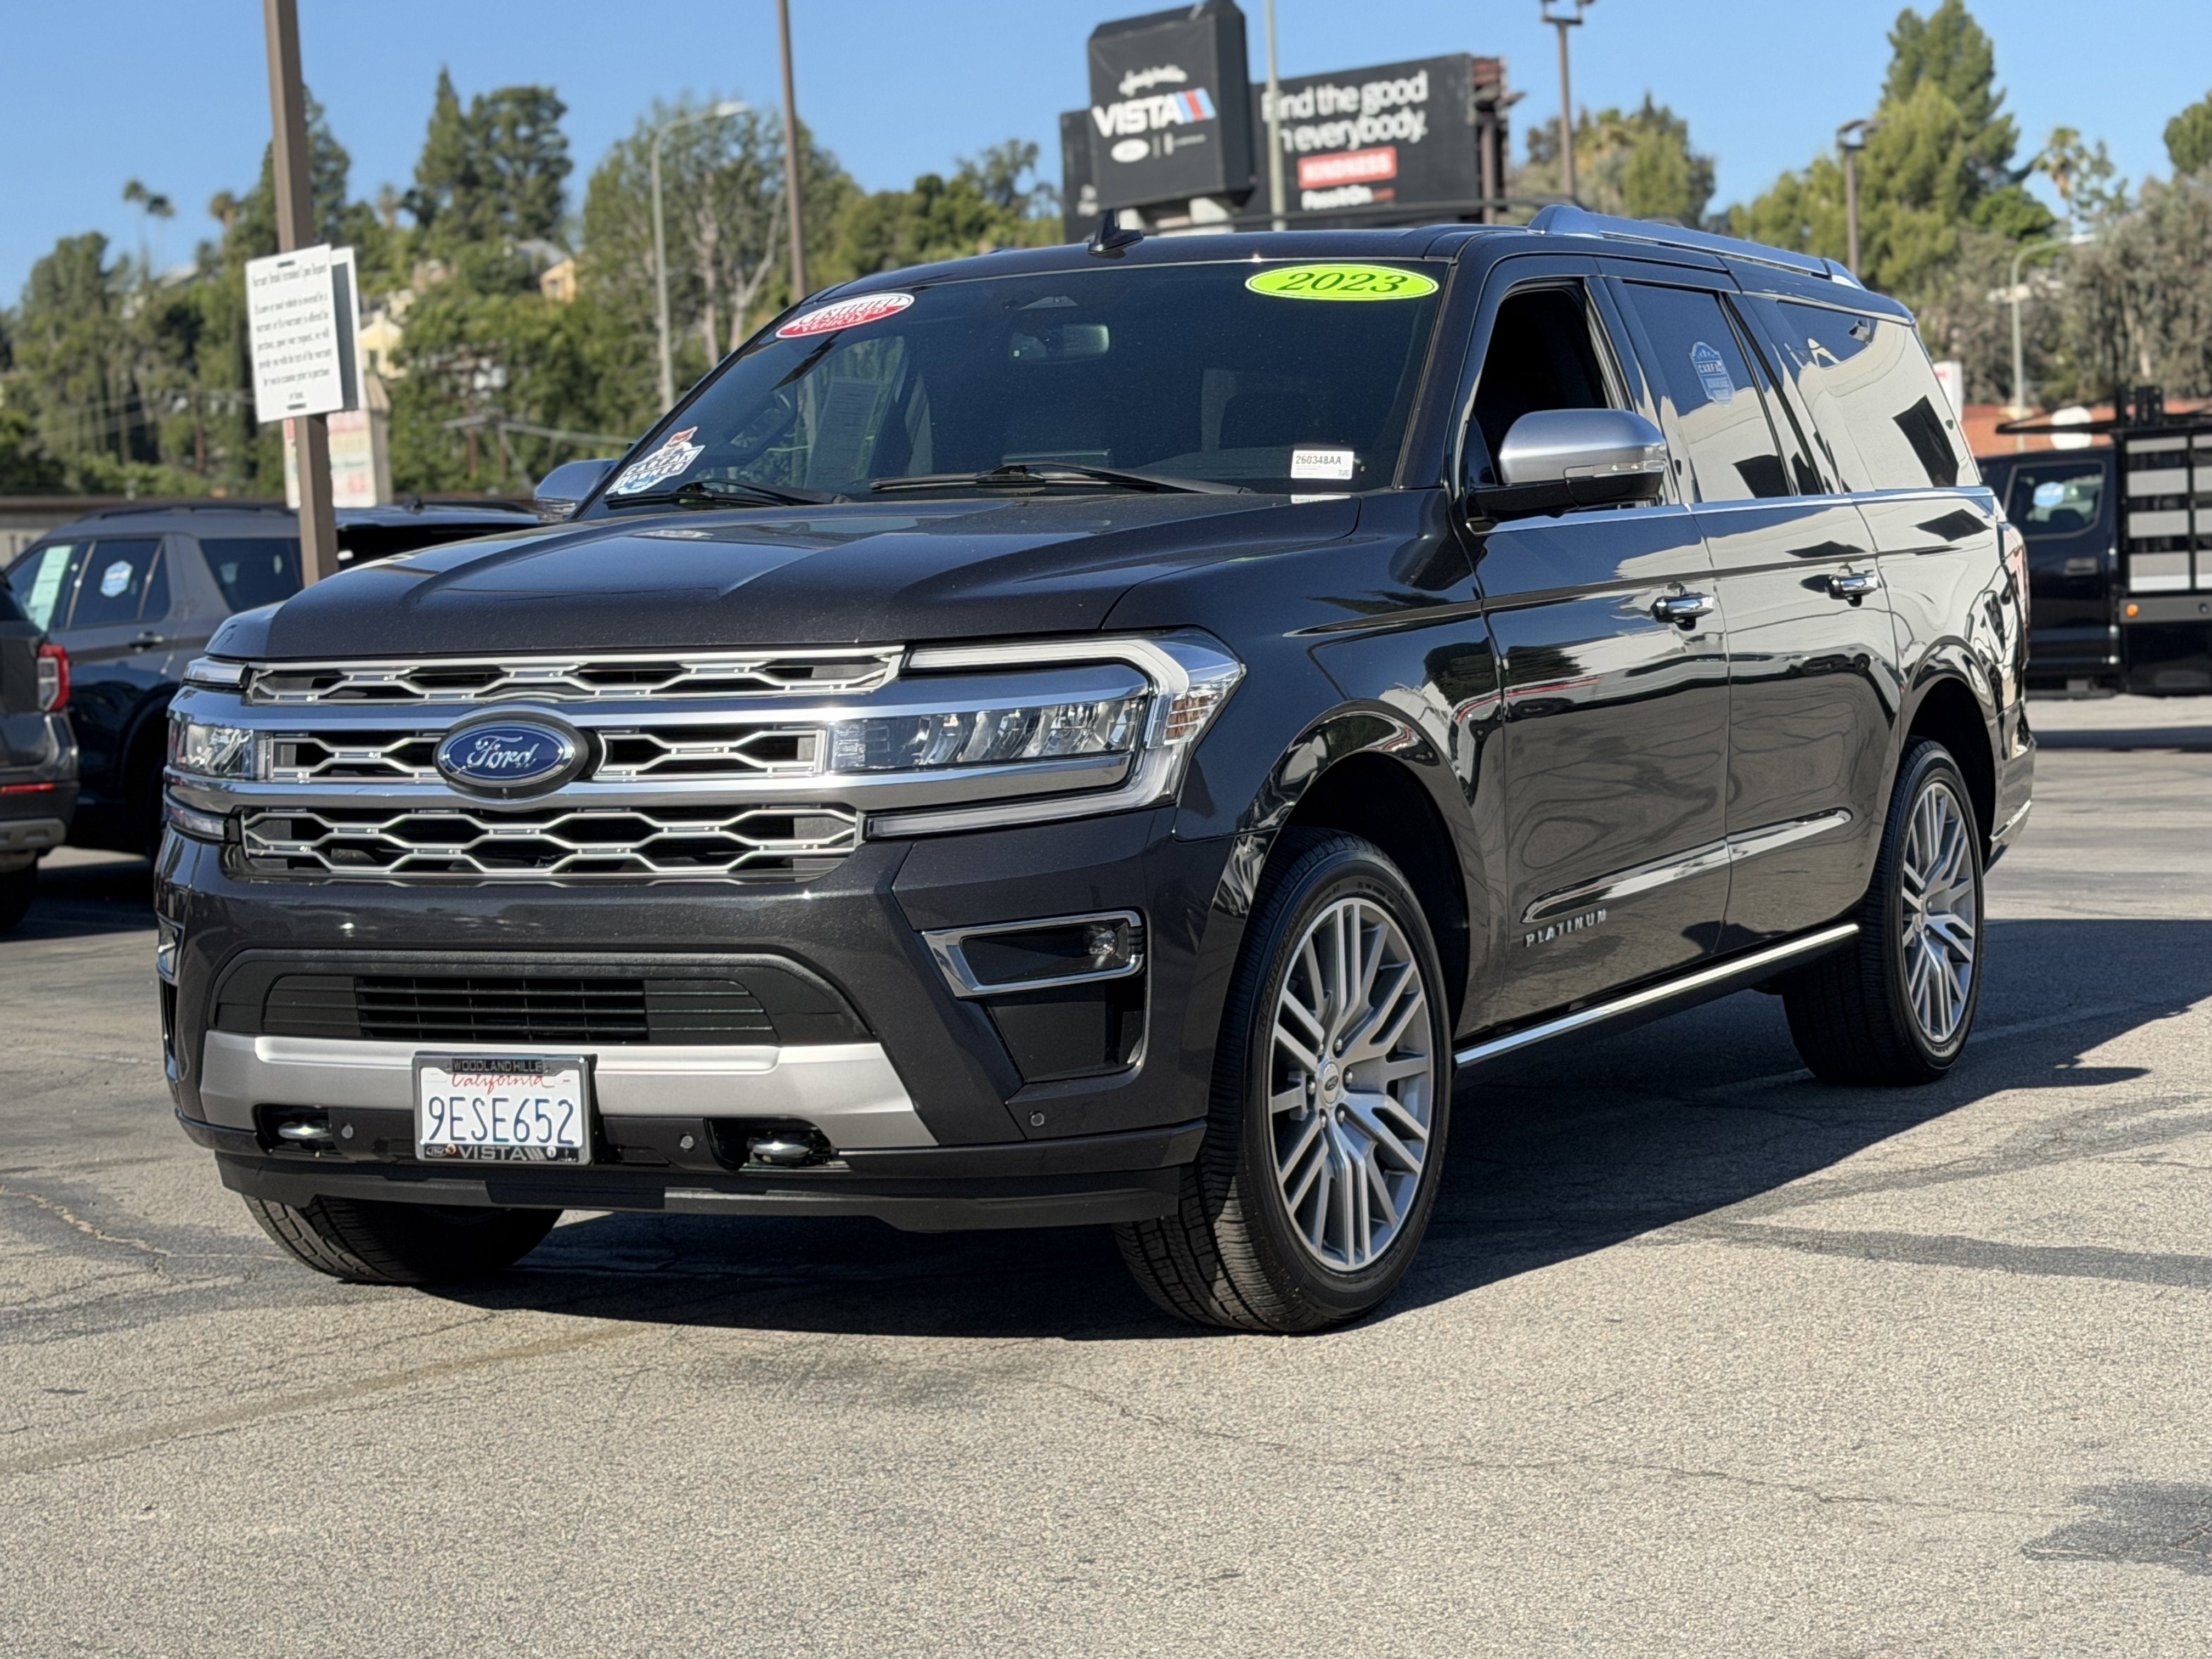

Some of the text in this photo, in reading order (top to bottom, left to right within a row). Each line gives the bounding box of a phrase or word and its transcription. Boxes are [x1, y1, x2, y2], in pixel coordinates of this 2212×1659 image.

[1261, 69, 1429, 122] Fnd the good
[1092, 93, 1186, 137] VISTA
[1276, 272, 1408, 293] 2023
[1295, 455, 1342, 465] 260348AA
[467, 736, 540, 769] Ford
[1525, 908, 1607, 948] PLATINUM
[453, 1060, 511, 1073] WOODLAND
[451, 1073, 555, 1094] California
[428, 1096, 575, 1146] 9ESE652
[458, 1146, 526, 1160] VISTA
